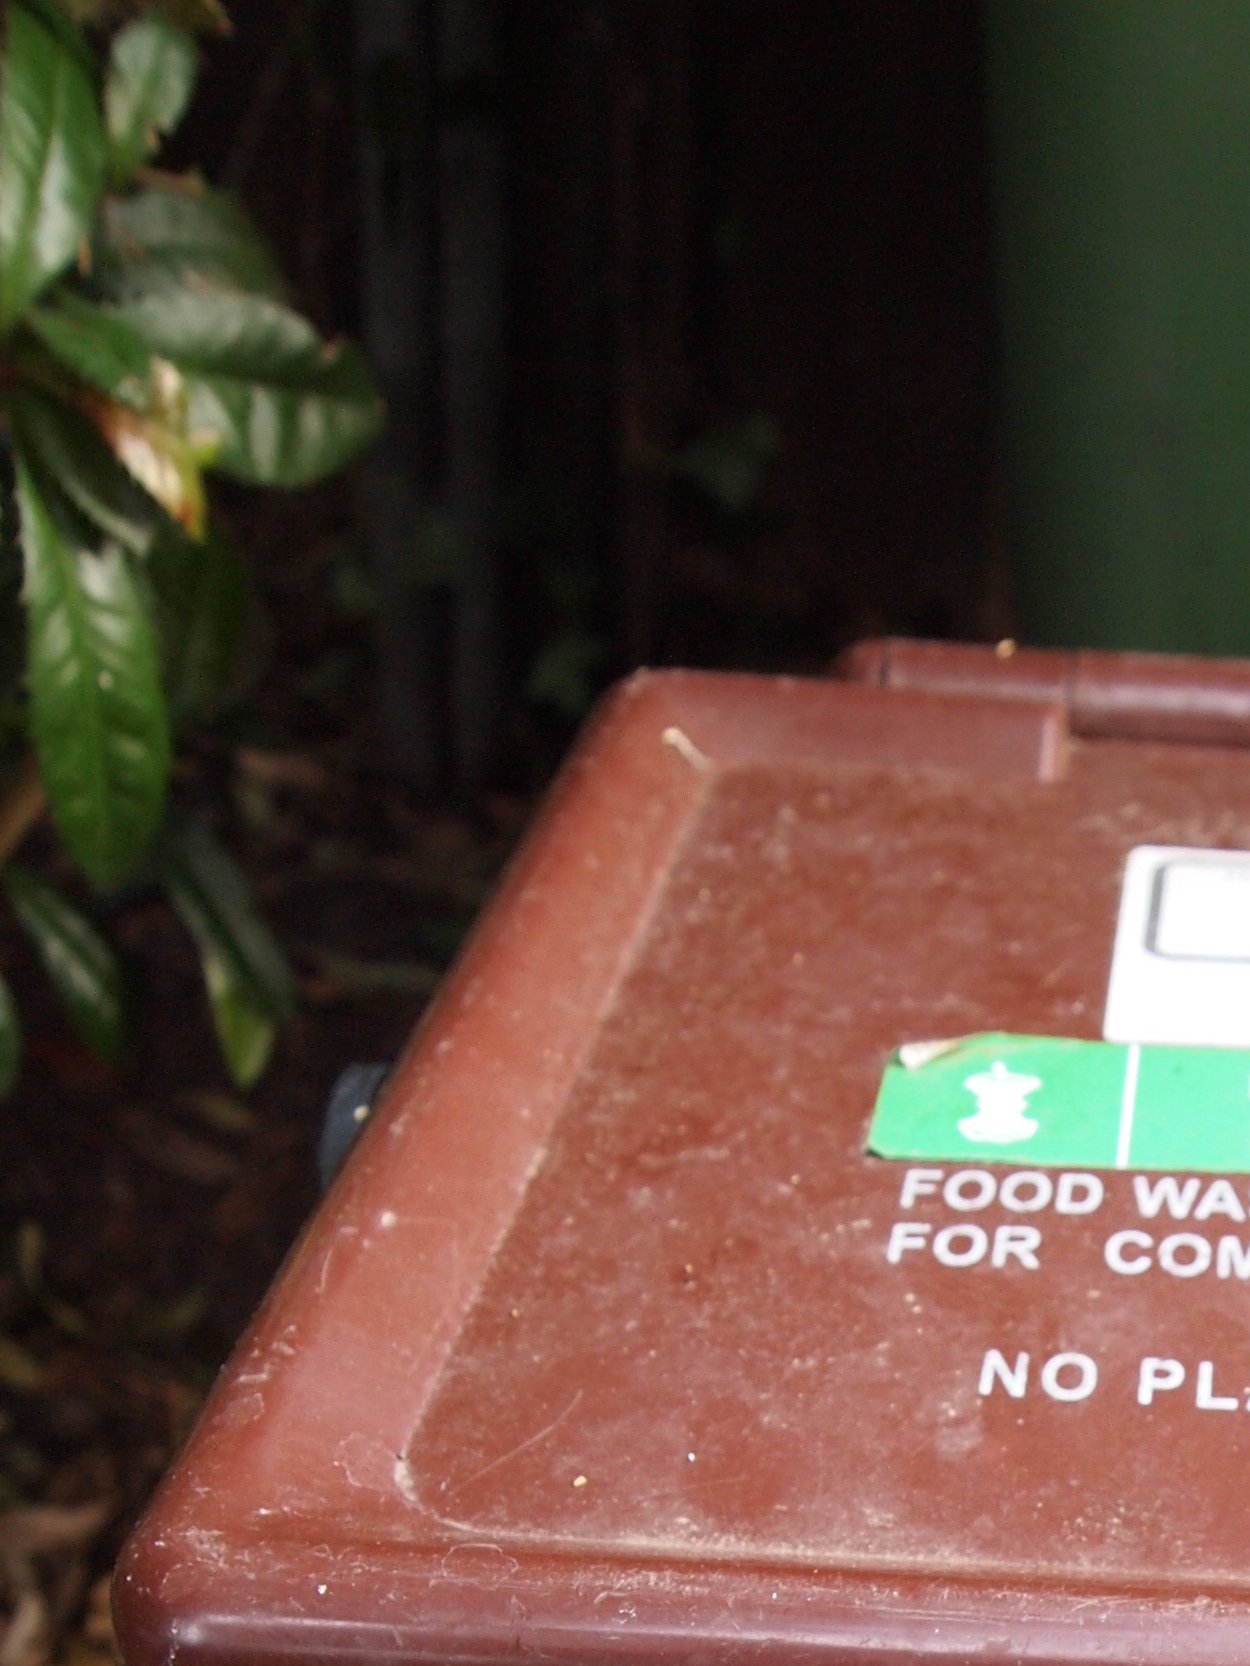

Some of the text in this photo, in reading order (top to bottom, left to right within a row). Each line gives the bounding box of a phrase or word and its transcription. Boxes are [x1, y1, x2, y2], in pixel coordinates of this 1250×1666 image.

[899, 1166, 1105, 1215] FOOD
[886, 1223, 1043, 1270] FOR
[978, 1348, 1098, 1401] NO
